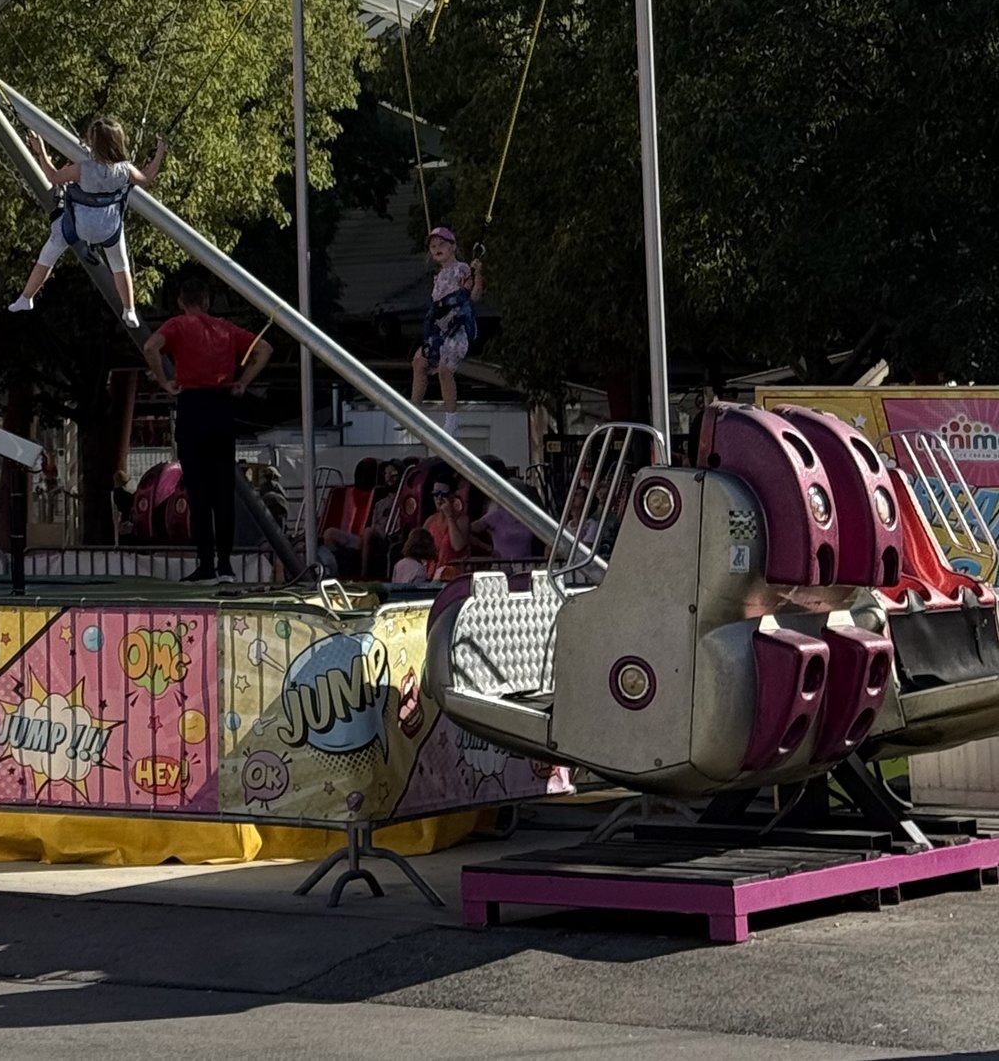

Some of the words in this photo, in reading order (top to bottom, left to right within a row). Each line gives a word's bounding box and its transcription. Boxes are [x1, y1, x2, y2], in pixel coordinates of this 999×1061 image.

[917, 422, 999, 450] minim
[118, 631, 192, 682] OMG
[277, 637, 387, 746] JUMP
[135, 759, 190, 789] HEY!
[250, 758, 284, 790] OK
